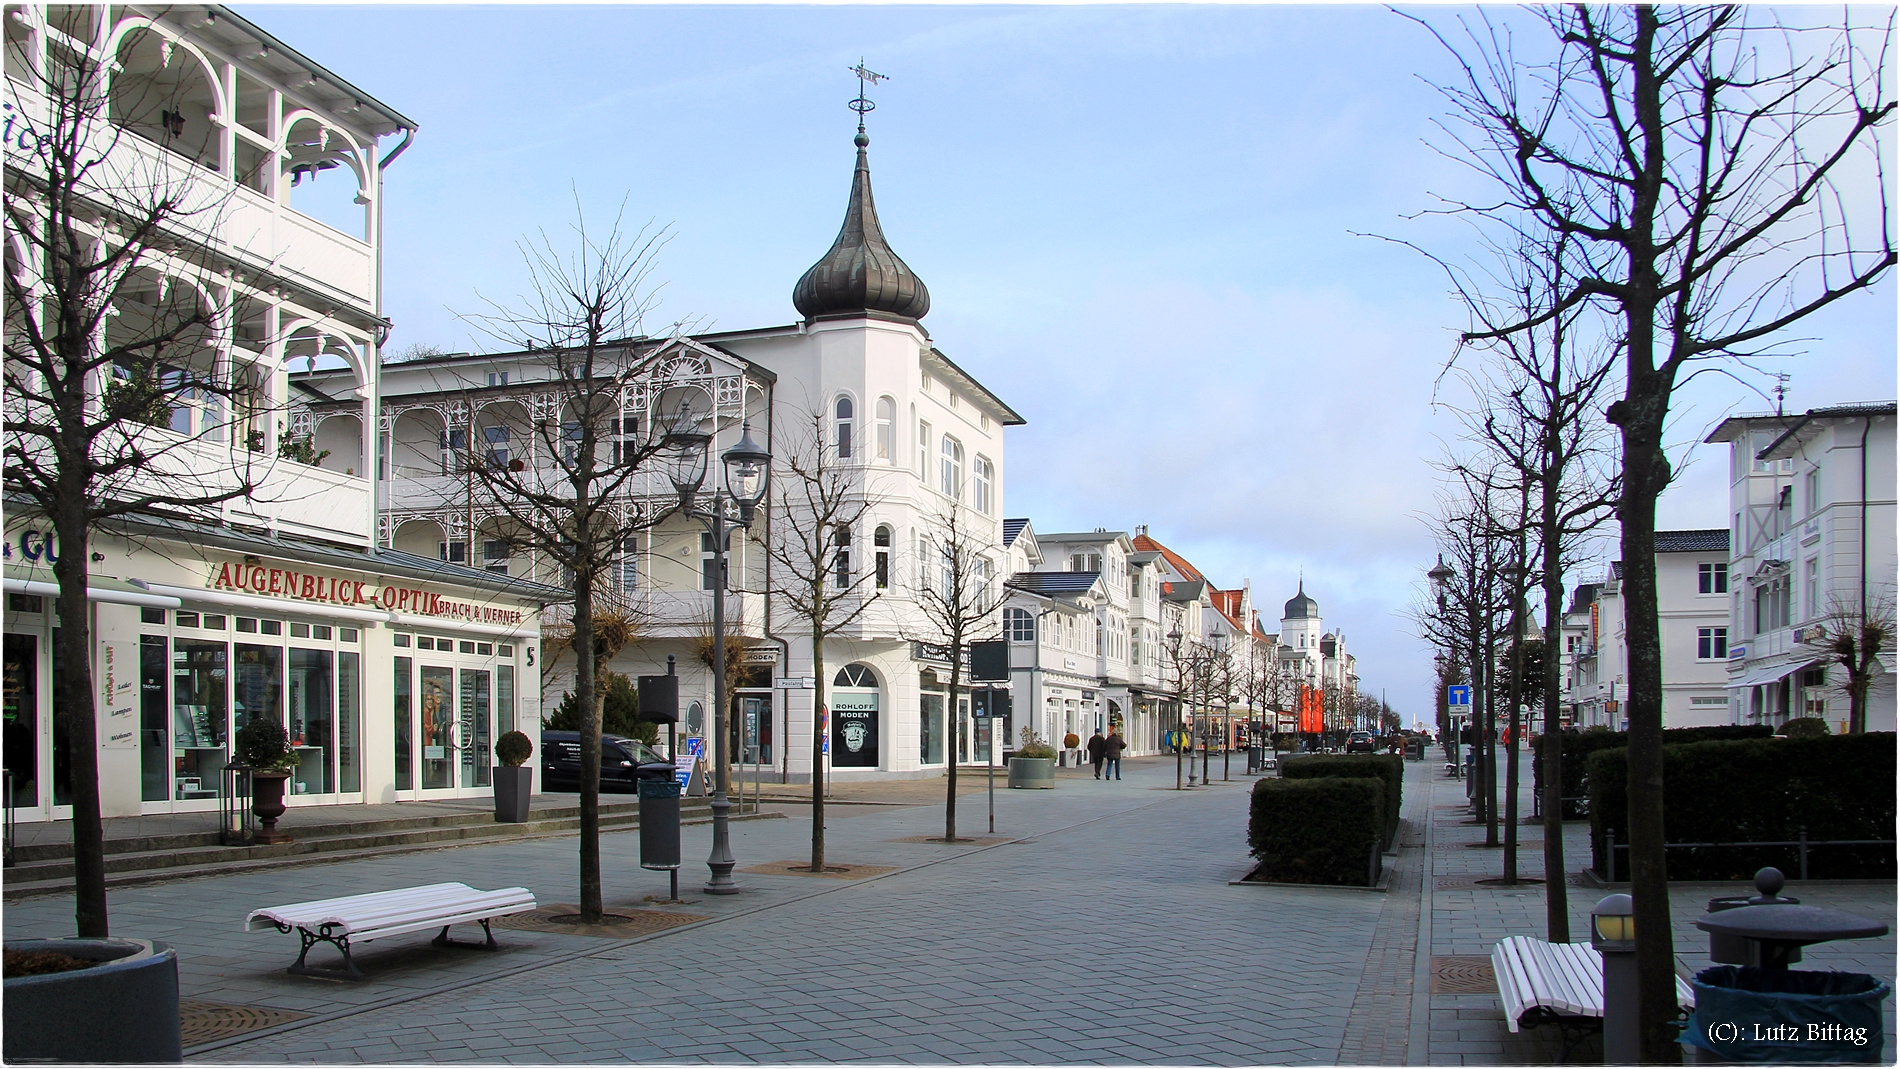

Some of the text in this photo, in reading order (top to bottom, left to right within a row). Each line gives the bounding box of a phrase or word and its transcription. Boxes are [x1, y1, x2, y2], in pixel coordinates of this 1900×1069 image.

[215, 562, 366, 604] AUGENBLICK
[383, 586, 442, 615] OPTIK
[439, 600, 521, 624] BRACH & WERNER
[527, 646, 535, 667] 5
